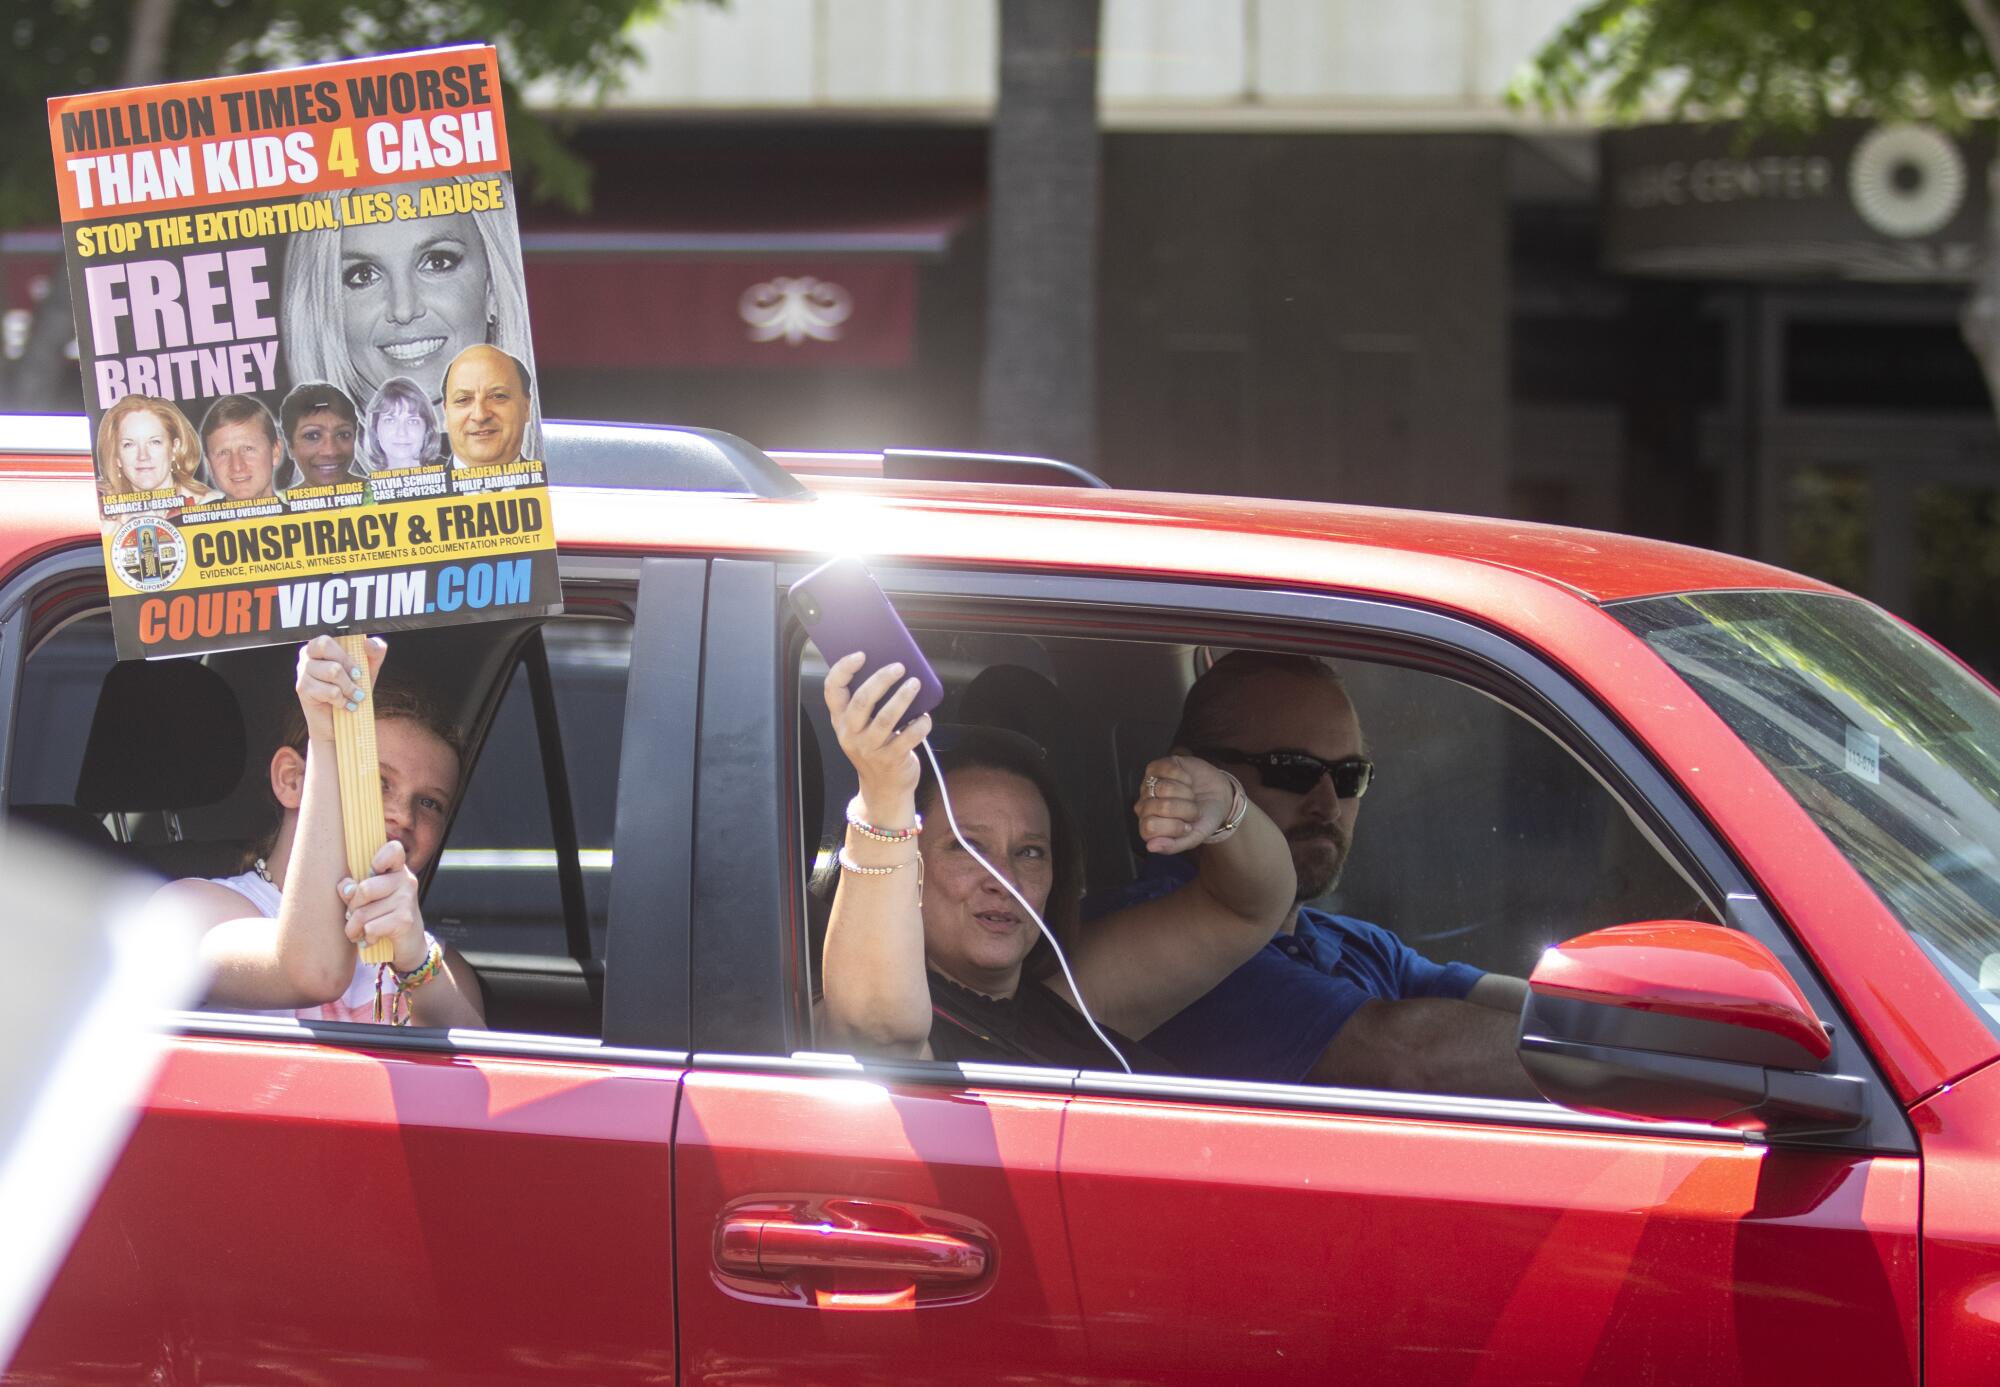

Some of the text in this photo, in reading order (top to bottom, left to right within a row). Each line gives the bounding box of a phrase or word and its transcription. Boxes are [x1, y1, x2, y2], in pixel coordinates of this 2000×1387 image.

[61, 63, 491, 153] MILLION TIMES WORSE
[66, 110, 497, 209] THAN KIDS 4 CASH
[75, 180, 503, 257] STOP THE EXTORTION, LIES & ABUSE
[85, 247, 278, 356] FREE
[94, 341, 279, 410] BRITNEY
[371, 465, 444, 479] FRAUD UPON THE COURT
[451, 461, 542, 481] PASADENA LAWYER
[287, 482, 364, 500] PRESIDING JUDGE
[371, 473, 447, 491] SYLVIA SCHMIDT
[452, 473, 544, 492] PHILIP BARBARO JR.
[102, 488, 176, 505] LOS ANGELES JUDGE
[290, 497, 327, 511] BRENDA
[335, 493, 363, 506] PENNY
[373, 489, 396, 500] CASE
[104, 502, 142, 515] CANDACE
[151, 496, 185, 509] BEASON
[181, 497, 279, 514] GLENDALE/LA CRESENTA LAWYER
[182, 504, 282, 523] CHRISTOPHER OVERGAARD
[115, 524, 132, 546] COUNTY
[156, 520, 180, 540] ANGELES
[192, 497, 543, 569] CONSPIRACY & FRAUD
[200, 534, 541, 580] EVIDENCE, FINANCIALS, WITNESS STATEMENTS & DOCUMENTATION PROVE IT
[135, 579, 171, 591] CALIFORNIA
[139, 558, 532, 644] COURTVICTIM.COM
